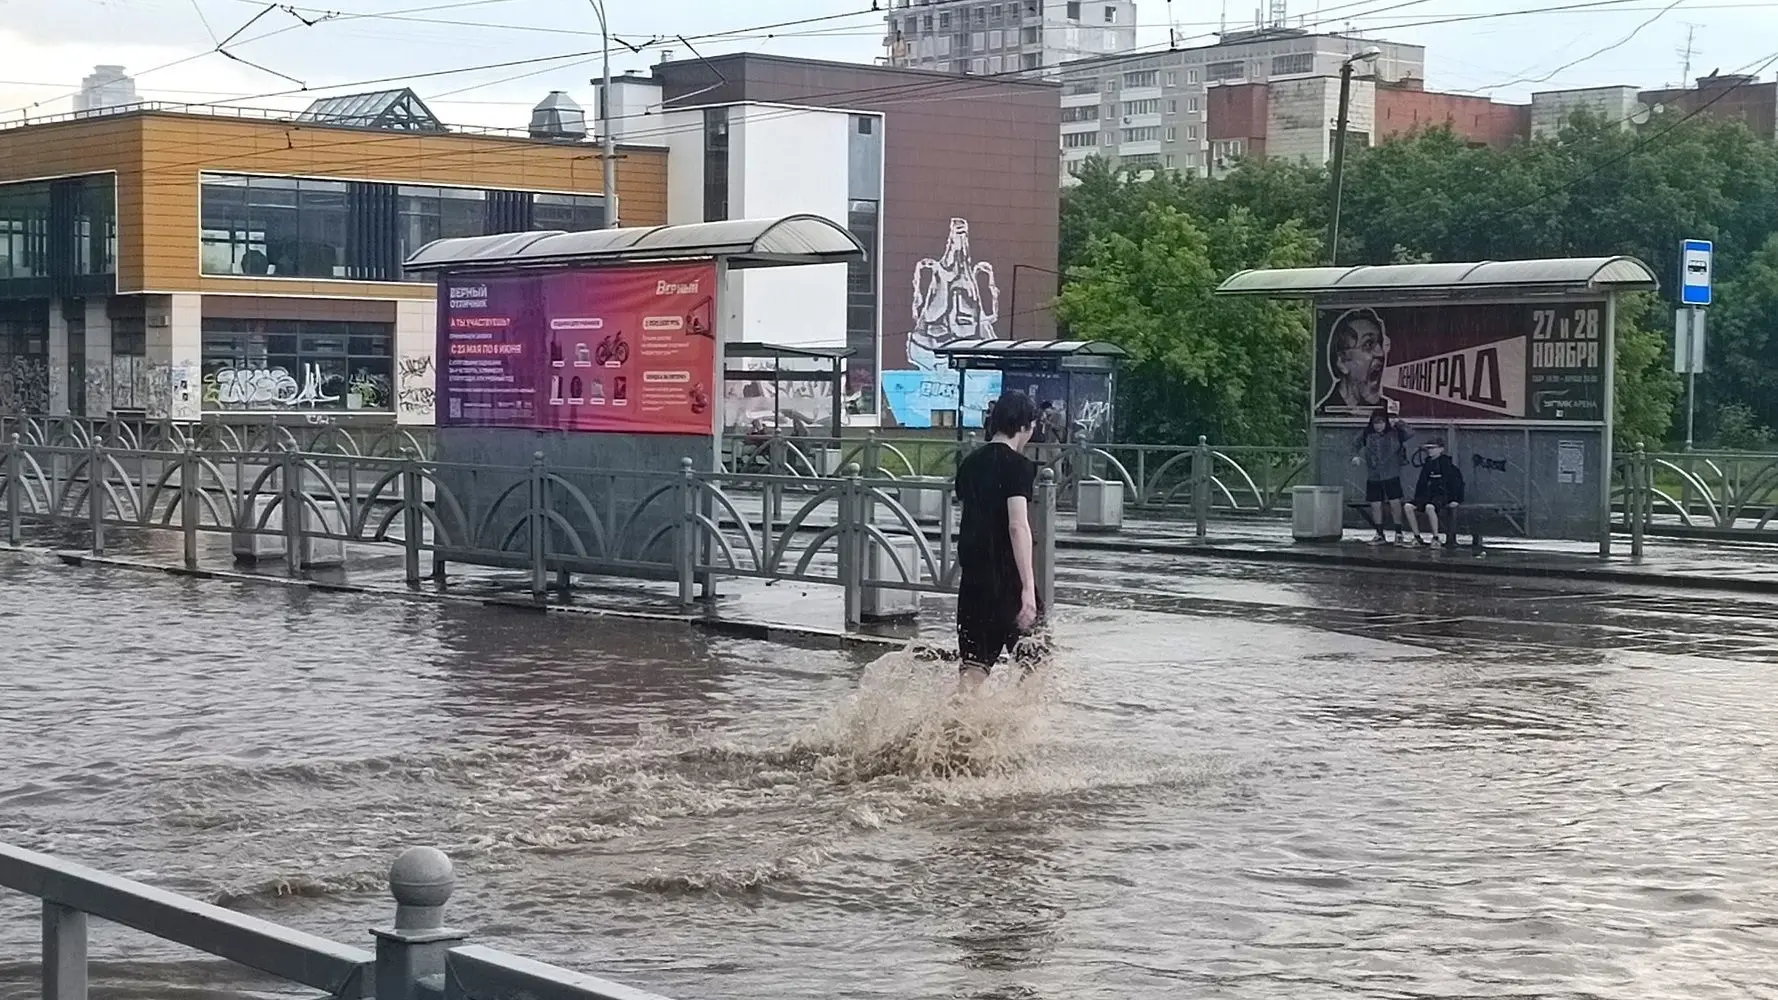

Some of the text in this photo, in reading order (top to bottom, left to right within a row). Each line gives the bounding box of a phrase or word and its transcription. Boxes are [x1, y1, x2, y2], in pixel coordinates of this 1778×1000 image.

[450, 284, 487, 298] ВЕРНЫЙ
[450, 299, 487, 308] ОТЛИЧНИК
[1533, 309, 1555, 339] 27
[1574, 309, 1599, 339] 28
[466, 344, 482, 354] МАЯ
[483, 344, 493, 354] ПО
[1532, 341, 1598, 368] НОЯБРЯ
[1398, 347, 1507, 408] ЛЕНИНГРАД
